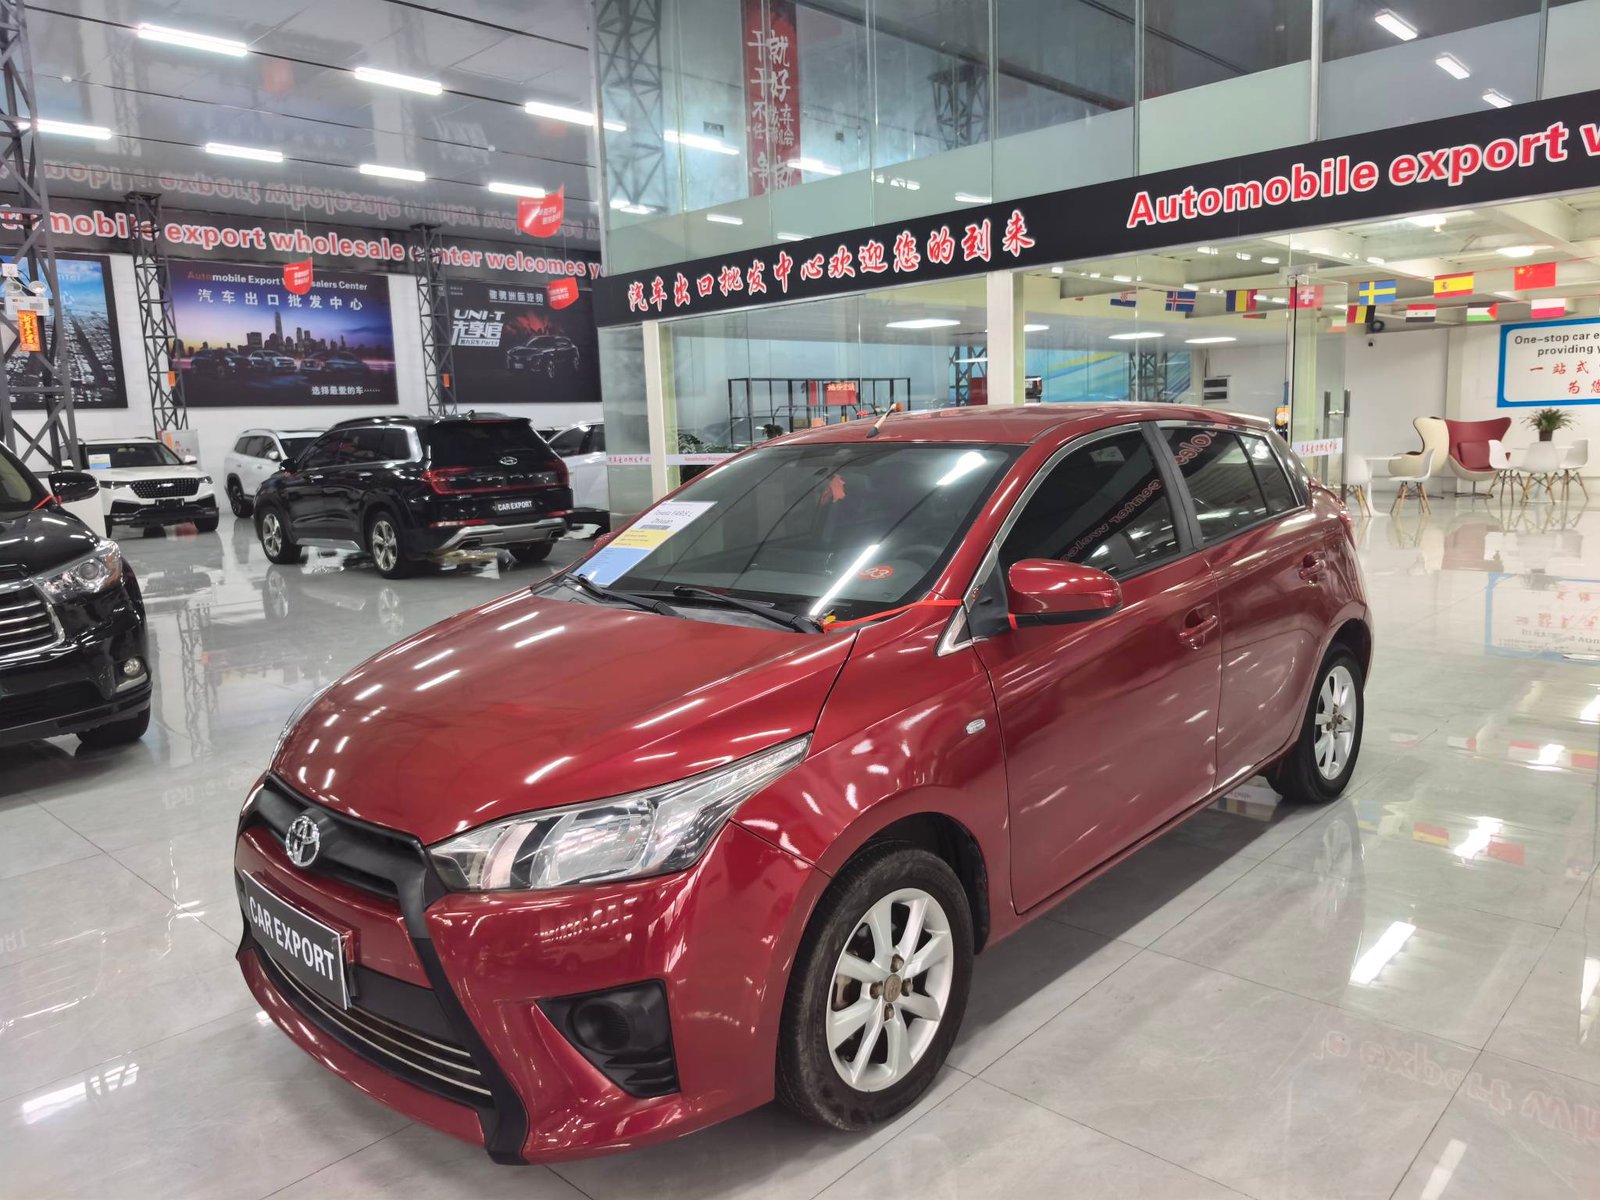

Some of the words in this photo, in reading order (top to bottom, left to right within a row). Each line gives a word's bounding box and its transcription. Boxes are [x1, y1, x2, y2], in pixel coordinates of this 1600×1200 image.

[1126, 155, 1379, 229] Automobile
[1389, 120, 1569, 187] export
[164, 222, 266, 250] export
[271, 229, 405, 261] wholesale
[487, 250, 587, 278] welcomes
[628, 209, 1036, 313] 汽车出口批发中心欢迎您的到来
[187, 270, 247, 284] Automobile
[248, 274, 280, 286] Export
[338, 280, 368, 291] Center
[198, 289, 364, 311] 汽车出口批发中心
[453, 309, 505, 321] UNI-T
[1514, 333, 1570, 345] One-stop
[1572, 332, 1591, 341] car
[1537, 344, 1594, 357] providing
[497, 502, 511, 512] CAR
[511, 501, 533, 510] EXPORT
[249, 896, 274, 940] CAR
[273, 915, 334, 981] EXPORT
